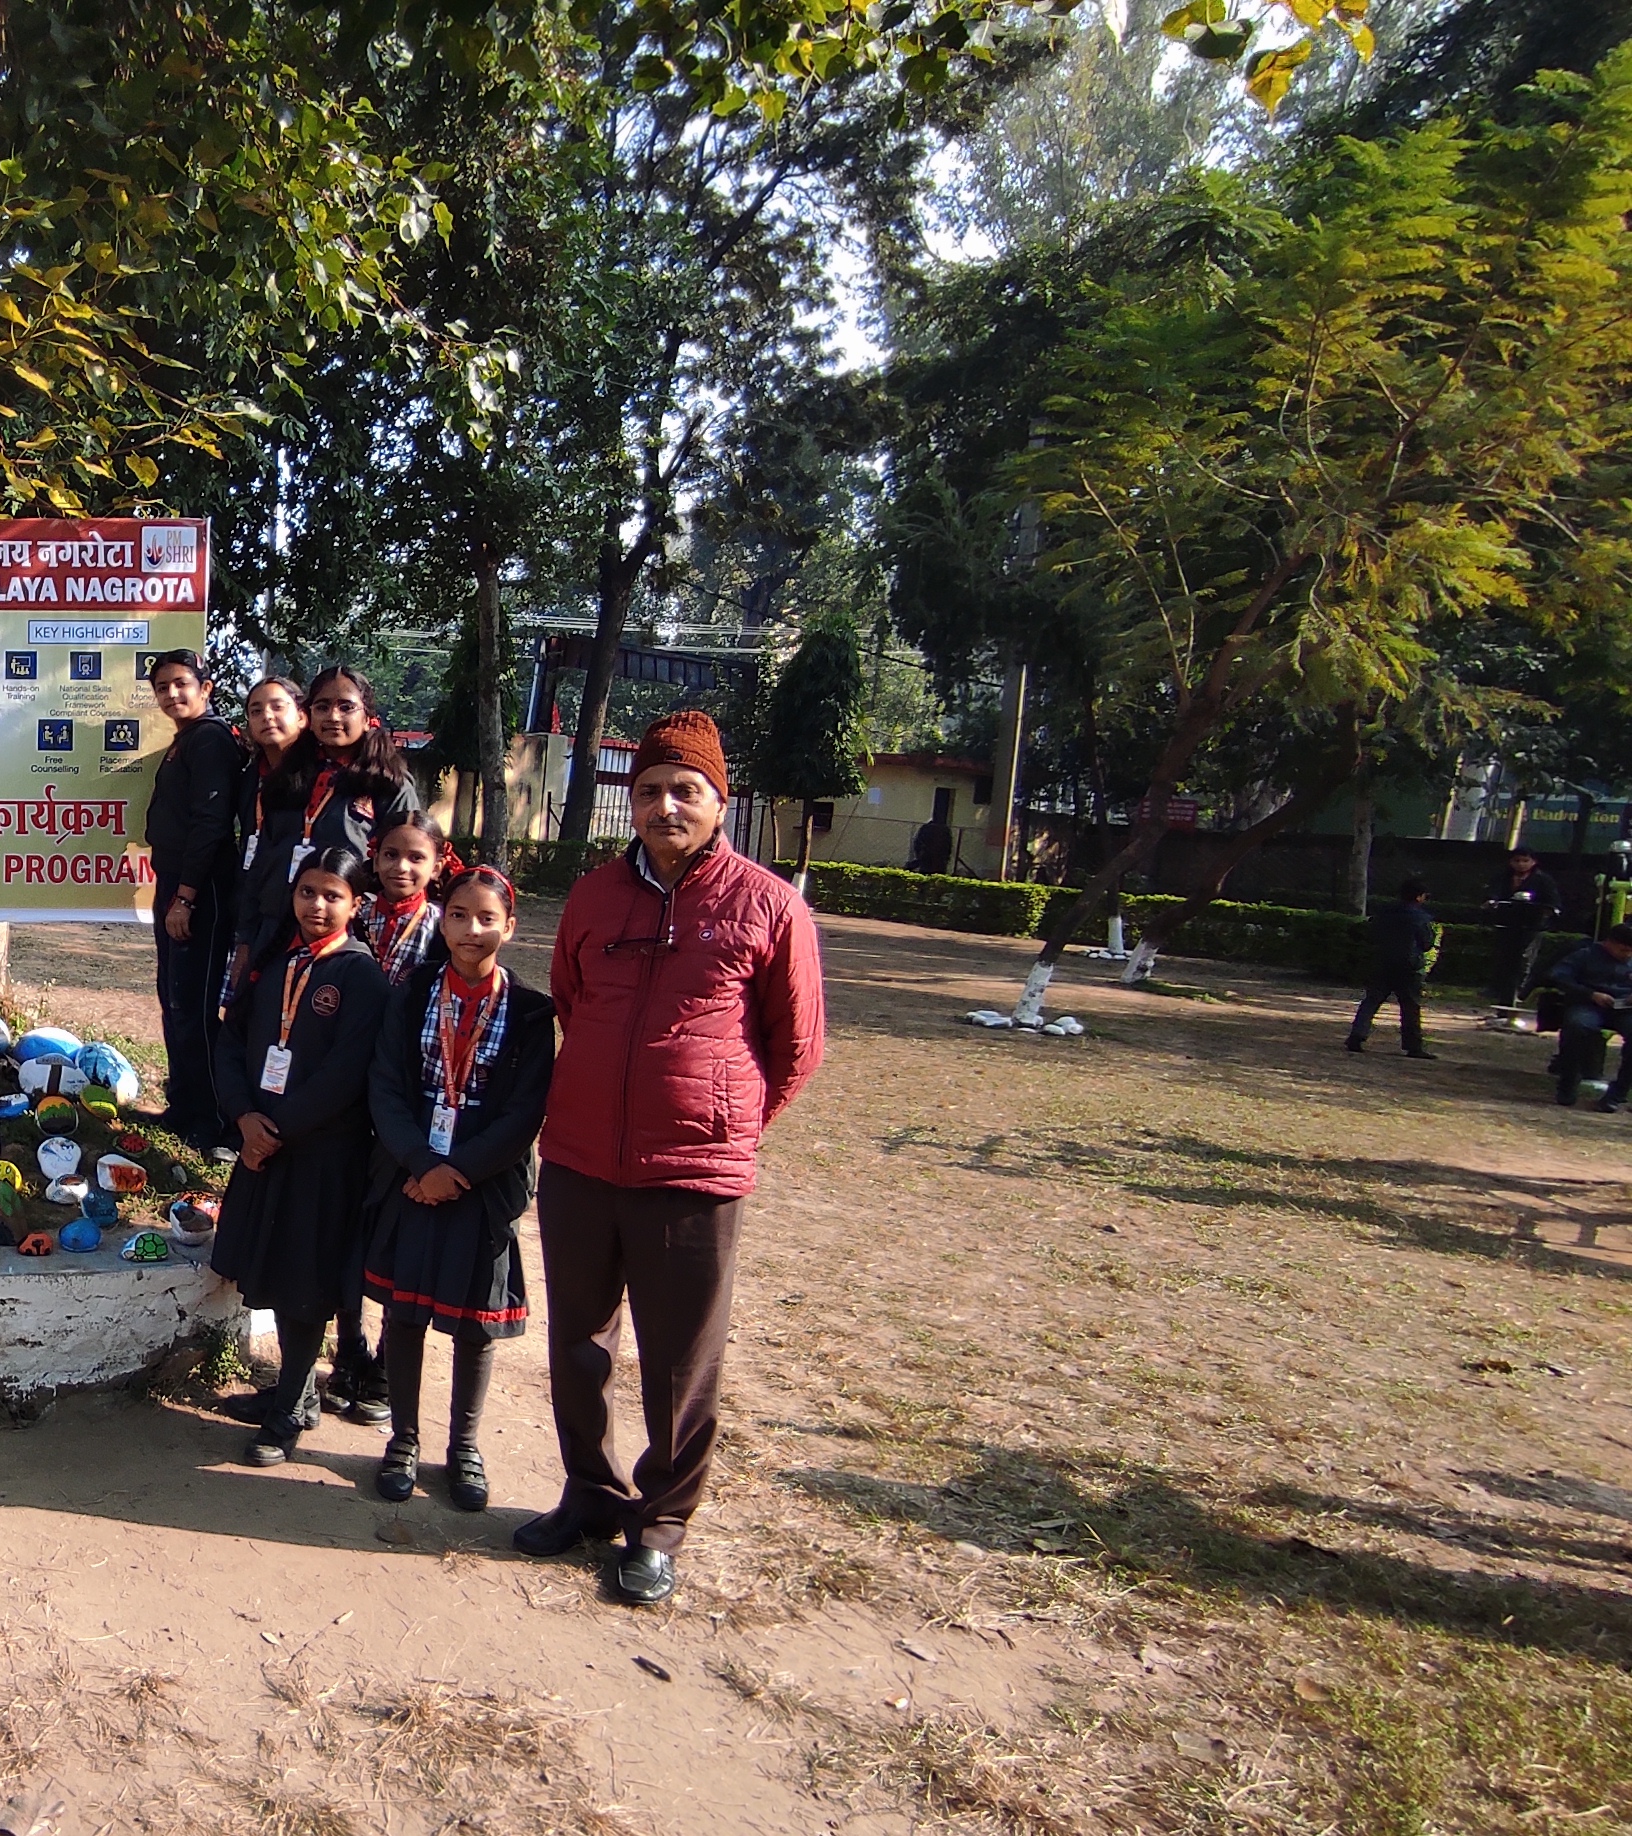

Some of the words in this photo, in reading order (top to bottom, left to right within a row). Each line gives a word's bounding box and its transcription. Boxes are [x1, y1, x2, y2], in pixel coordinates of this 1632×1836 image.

[167, 530, 182, 545] PM
[37, 531, 135, 568] नगरोटा
[165, 545, 194, 563] SHRI
[66, 577, 195, 603] NAGROTA
[34, 626, 58, 639] KEY
[61, 626, 144, 640] HIGHLIGHTS:
[2, 684, 40, 692] Hands-on
[59, 684, 90, 692] National
[92, 684, 112, 692] Skills
[6, 692, 36, 701] Training
[62, 693, 109, 701] Qualification
[65, 701, 106, 709] Framework
[49, 709, 88, 717] Compliant
[90, 709, 121, 717] Courses
[44, 756, 63, 764] Free
[30, 765, 79, 774] Counselling
